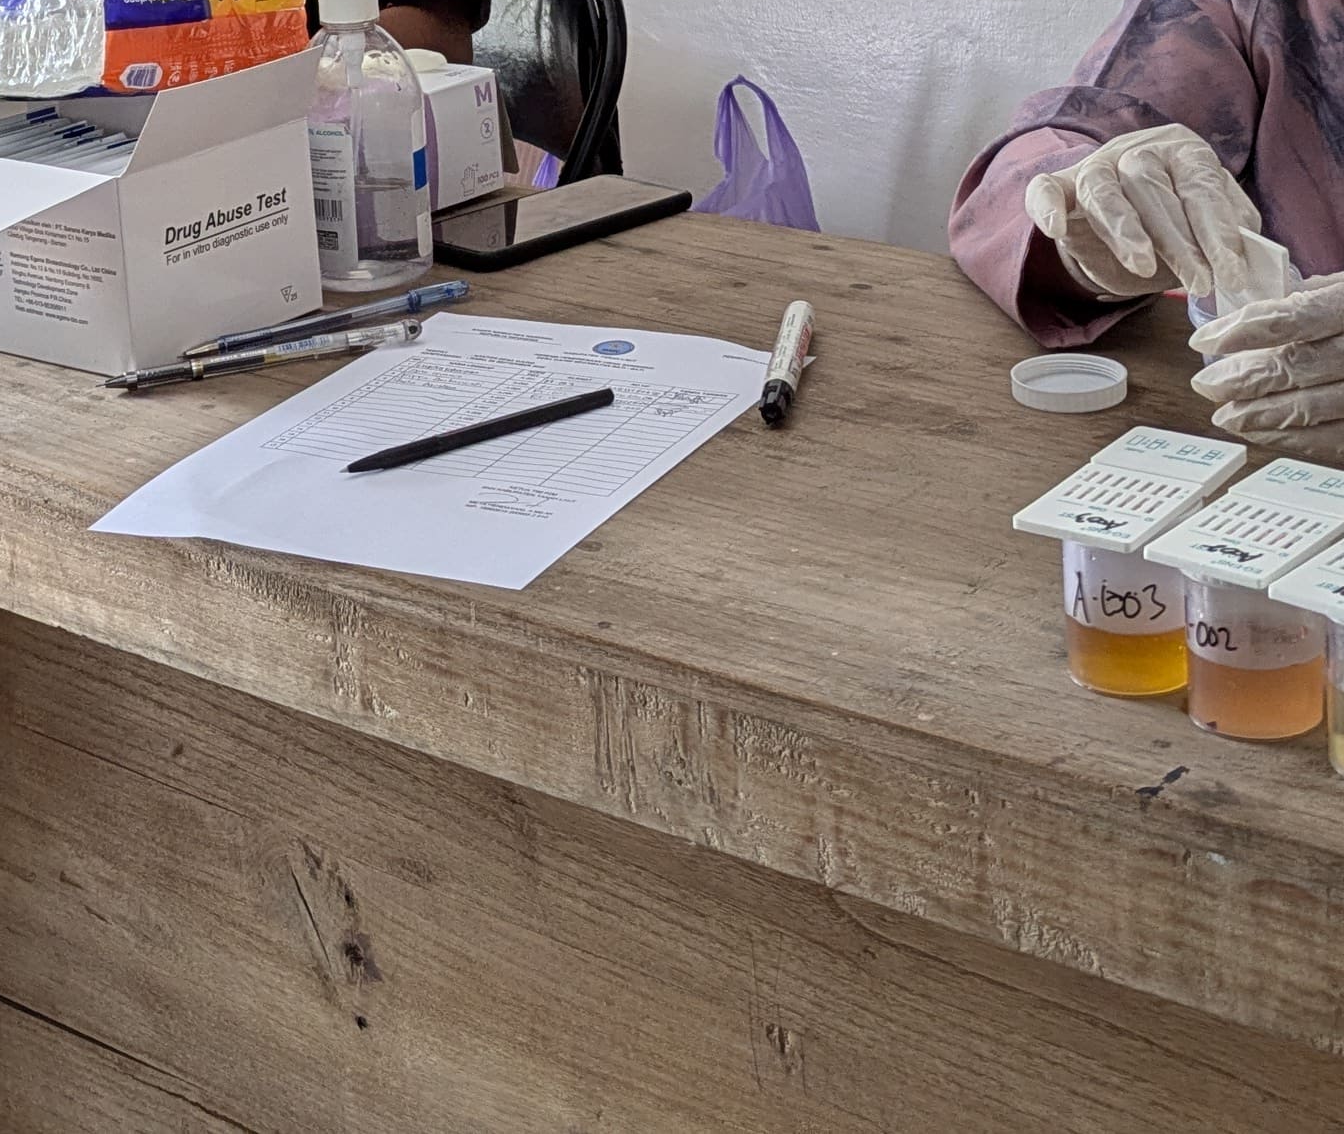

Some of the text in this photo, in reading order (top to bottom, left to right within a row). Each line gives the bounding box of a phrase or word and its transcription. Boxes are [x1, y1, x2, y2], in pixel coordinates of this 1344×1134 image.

[474, 81, 493, 107] M
[165, 187, 287, 246] Drug Abuse Test
[166, 214, 288, 266] For in vitro diagnostic use only
[1184, 620, 1239, 652] -002
